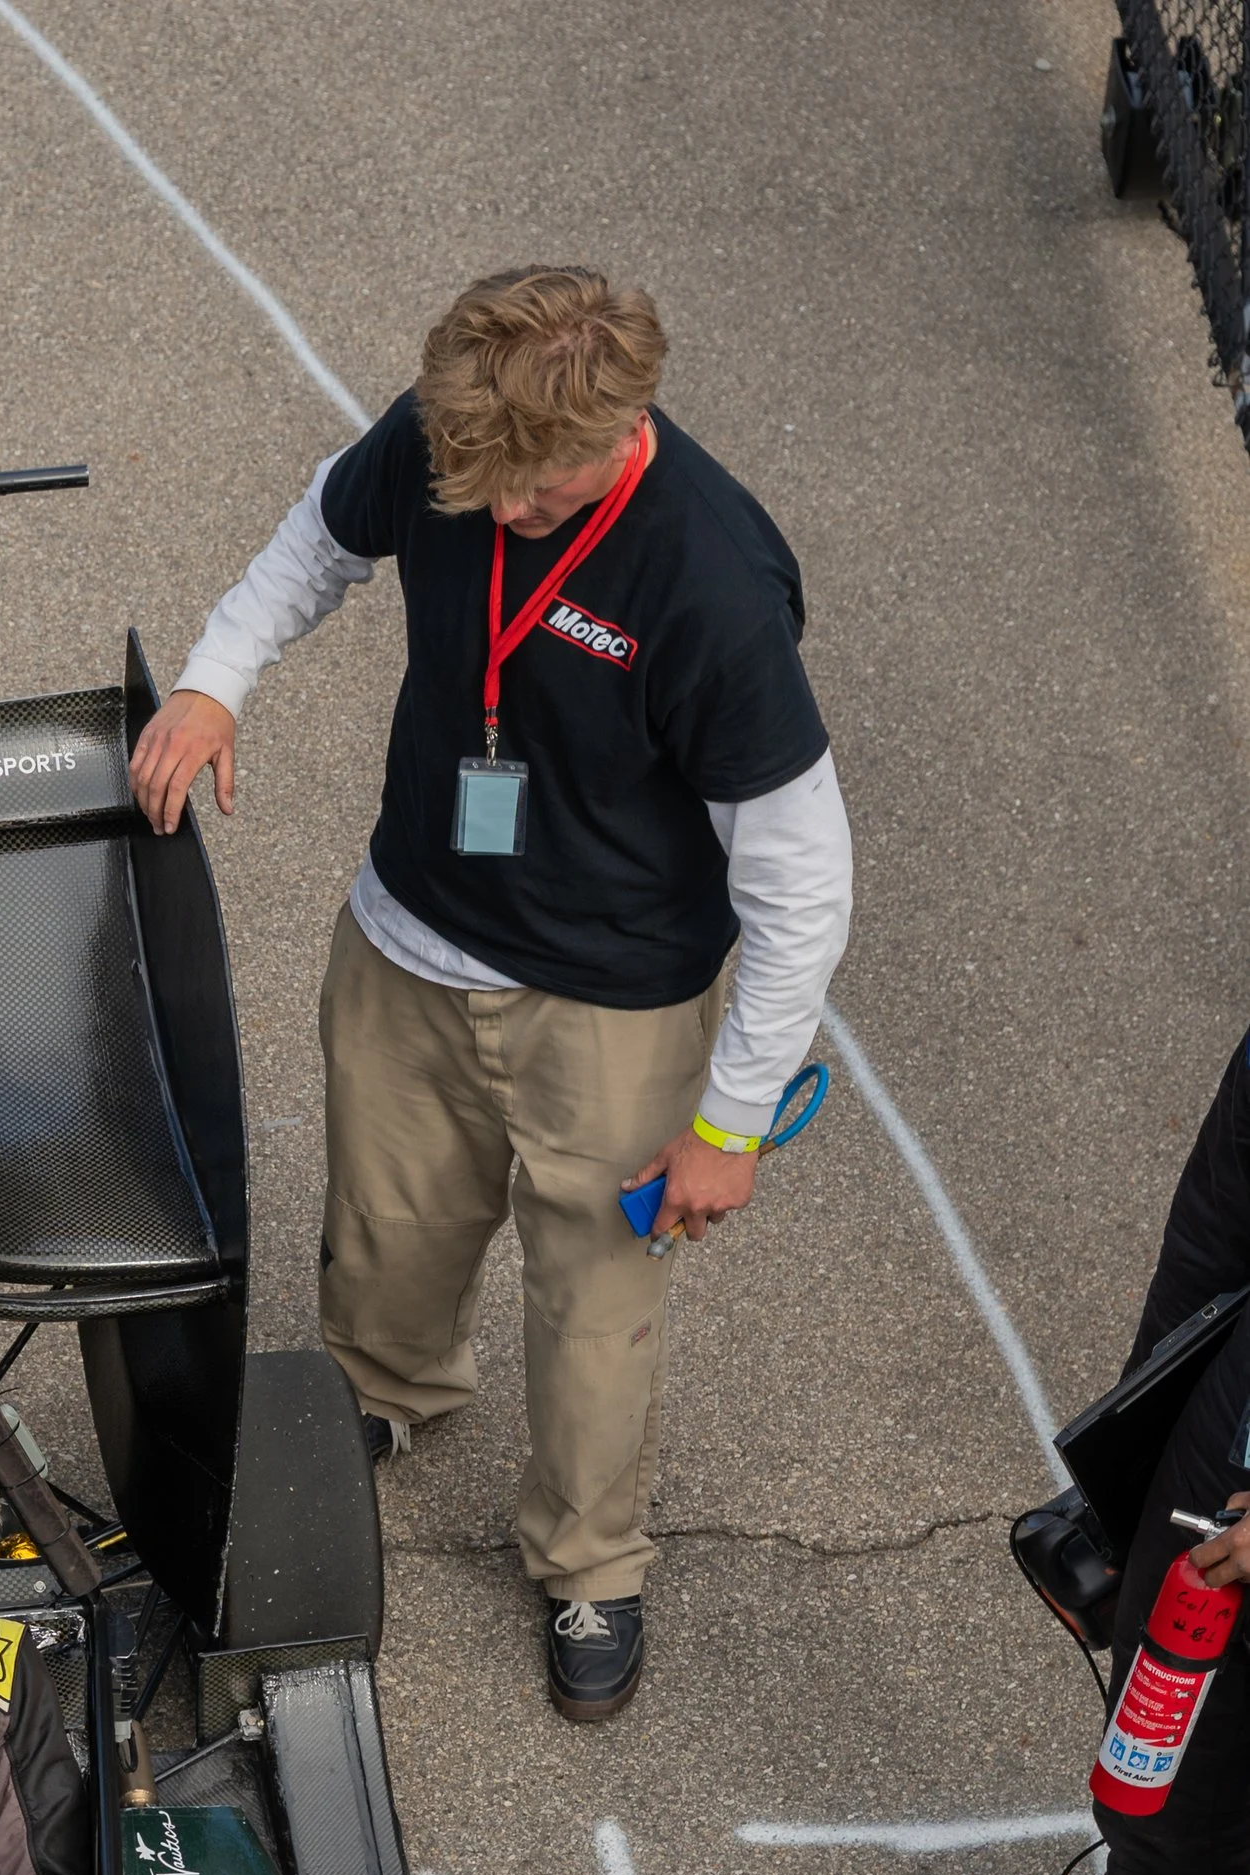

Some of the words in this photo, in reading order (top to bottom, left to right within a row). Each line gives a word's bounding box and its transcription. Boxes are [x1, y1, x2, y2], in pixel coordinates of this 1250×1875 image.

[548, 605, 627, 657] MoTeC
[1142, 1657, 1196, 1685] INSTRUCTIONS
[1113, 1764, 1132, 1779] First
[1132, 1774, 1156, 1784] Alert
